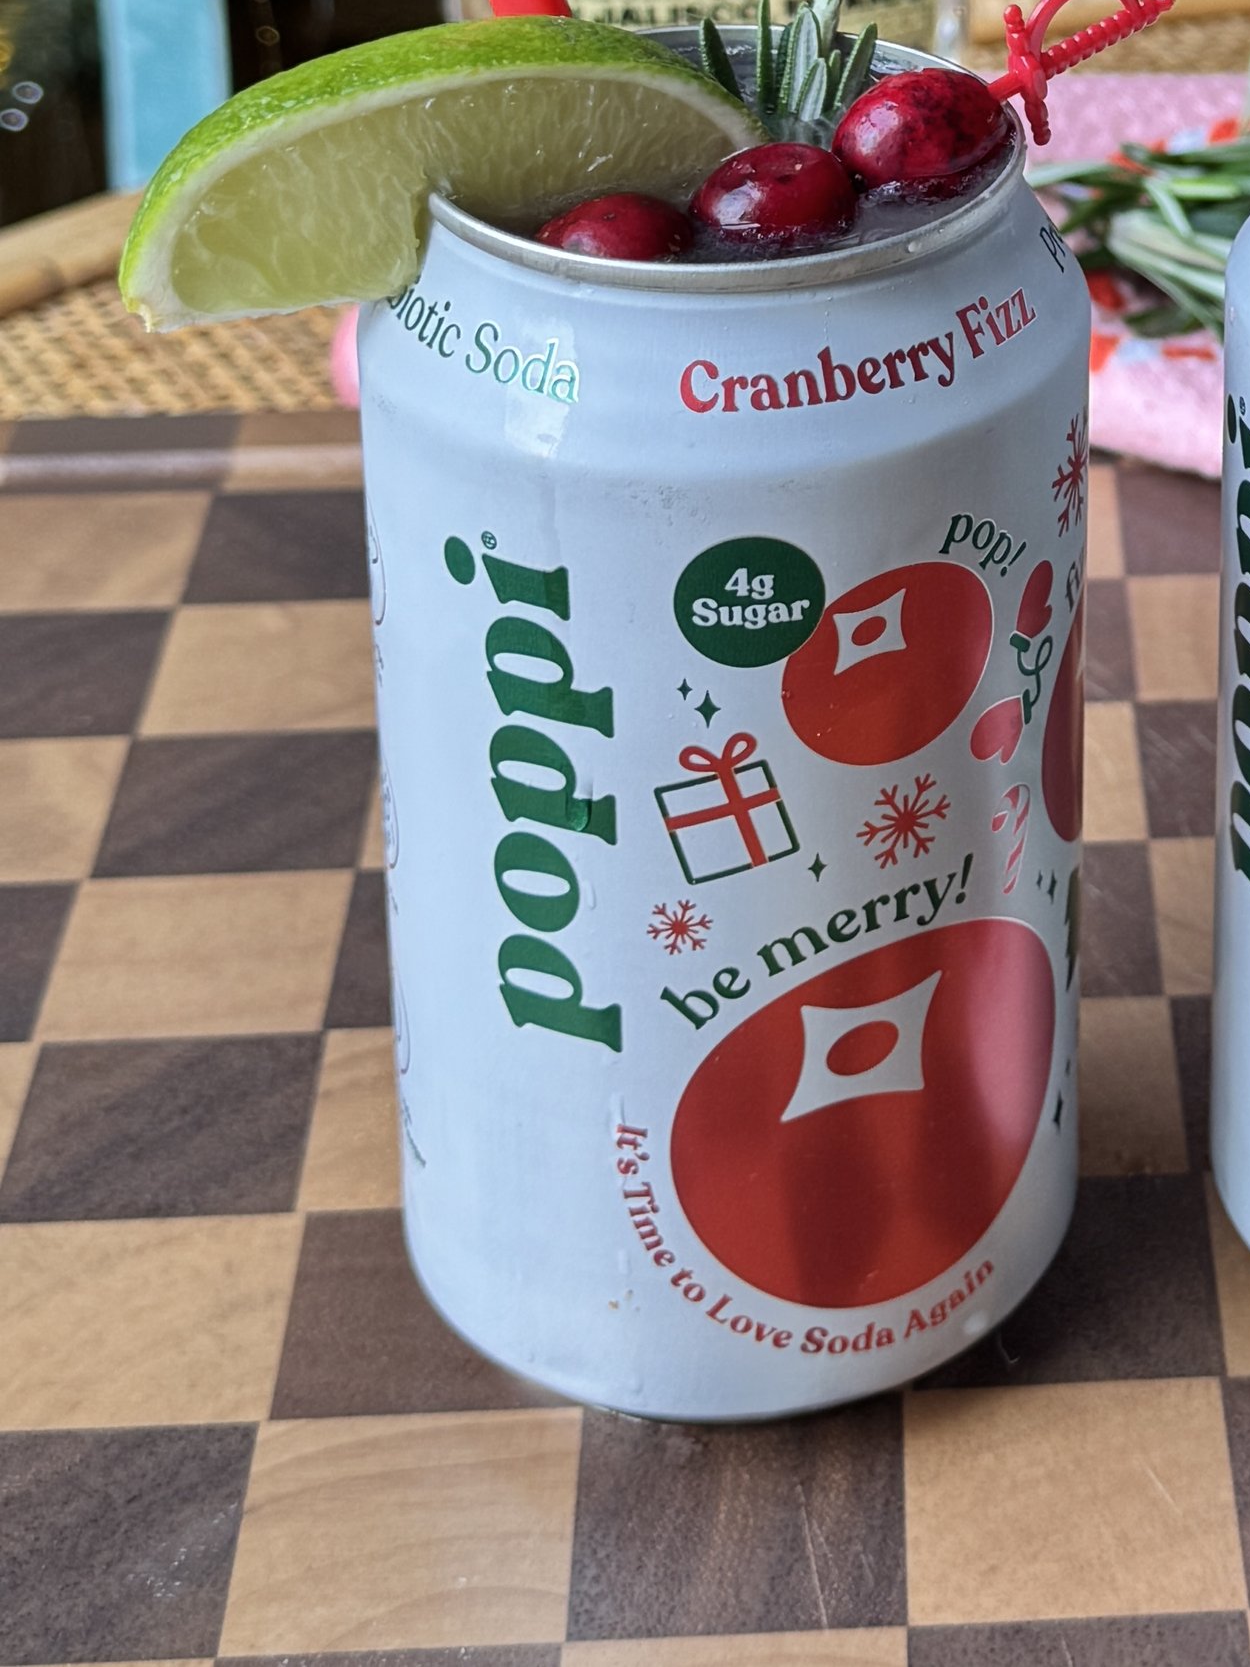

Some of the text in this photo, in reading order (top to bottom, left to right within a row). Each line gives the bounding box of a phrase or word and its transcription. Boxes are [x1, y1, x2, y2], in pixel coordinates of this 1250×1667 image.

[464, 322, 580, 405] Soda
[679, 287, 1038, 414] Cranberry Fizz
[724, 567, 775, 600] 4g
[937, 512, 1028, 579] pop!
[691, 597, 811, 630] Sugar
[659, 852, 974, 1031] be merry!
[622, 1180, 677, 1267] Time
[669, 1266, 707, 1303] to
[704, 1292, 794, 1349] Love
[800, 1321, 896, 1355] Soda
[903, 1259, 995, 1341] Again
